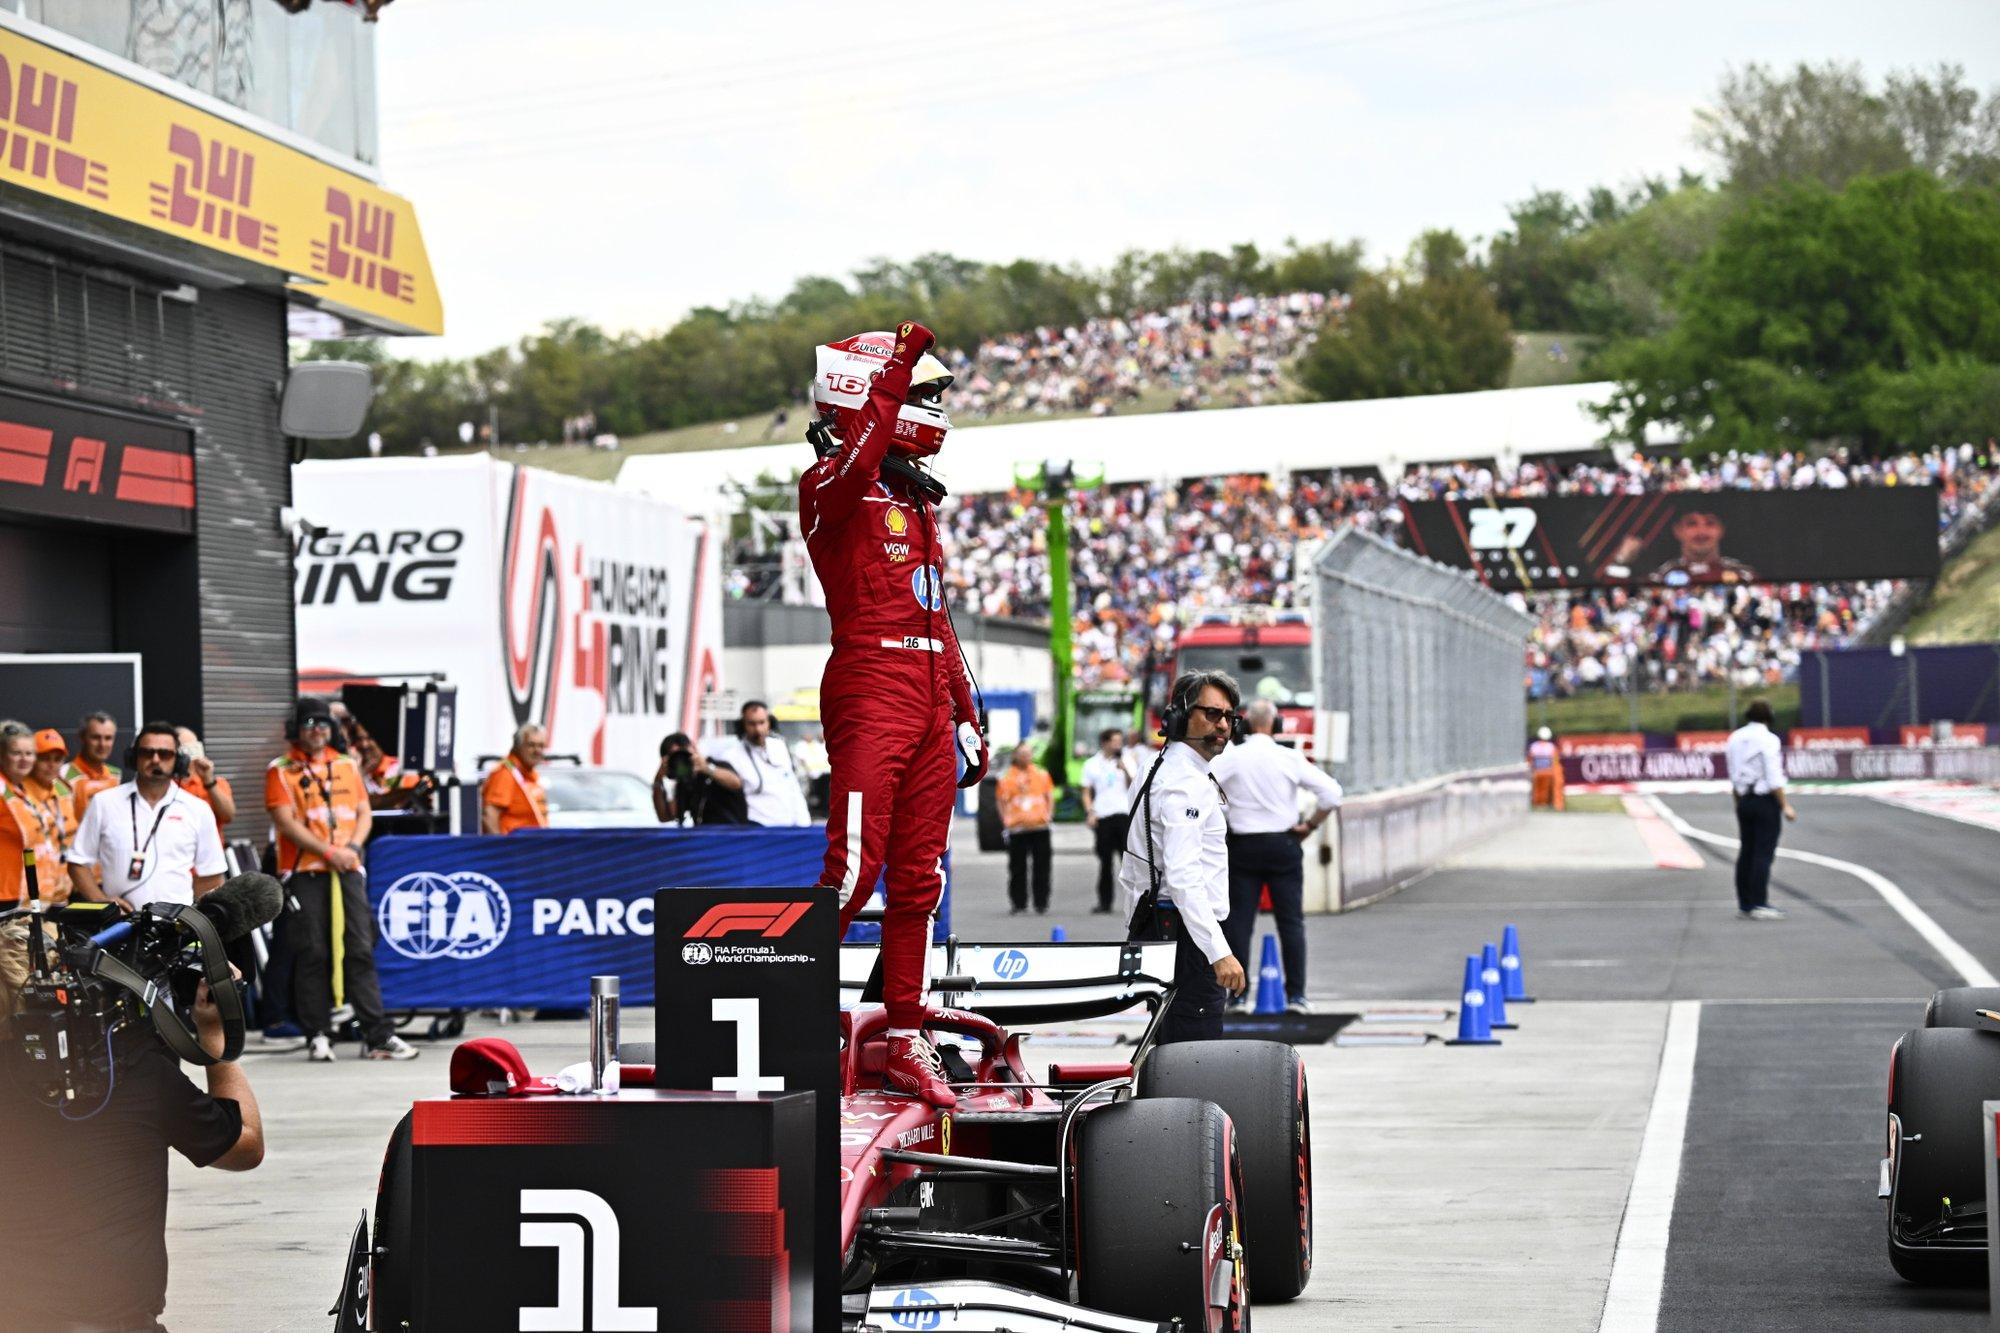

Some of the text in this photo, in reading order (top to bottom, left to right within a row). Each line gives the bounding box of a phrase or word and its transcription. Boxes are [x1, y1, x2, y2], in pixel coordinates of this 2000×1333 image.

[169, 123, 262, 250] DHL
[325, 186, 400, 299] DHL
[827, 372, 866, 395] 16
[858, 420, 876, 447] MILLE
[884, 542, 909, 555] VGW
[890, 554, 905, 562] PLAY
[905, 637, 919, 648] 16
[607, 624, 667, 714] RING
[532, 898, 654, 936] PARC
[714, 946, 775, 954] FIA Formula 1
[714, 955, 741, 963] World
[743, 954, 808, 963] Championship
[996, 950, 1026, 979] hp
[712, 998, 784, 1091] 1
[519, 1189, 658, 1332] 1
